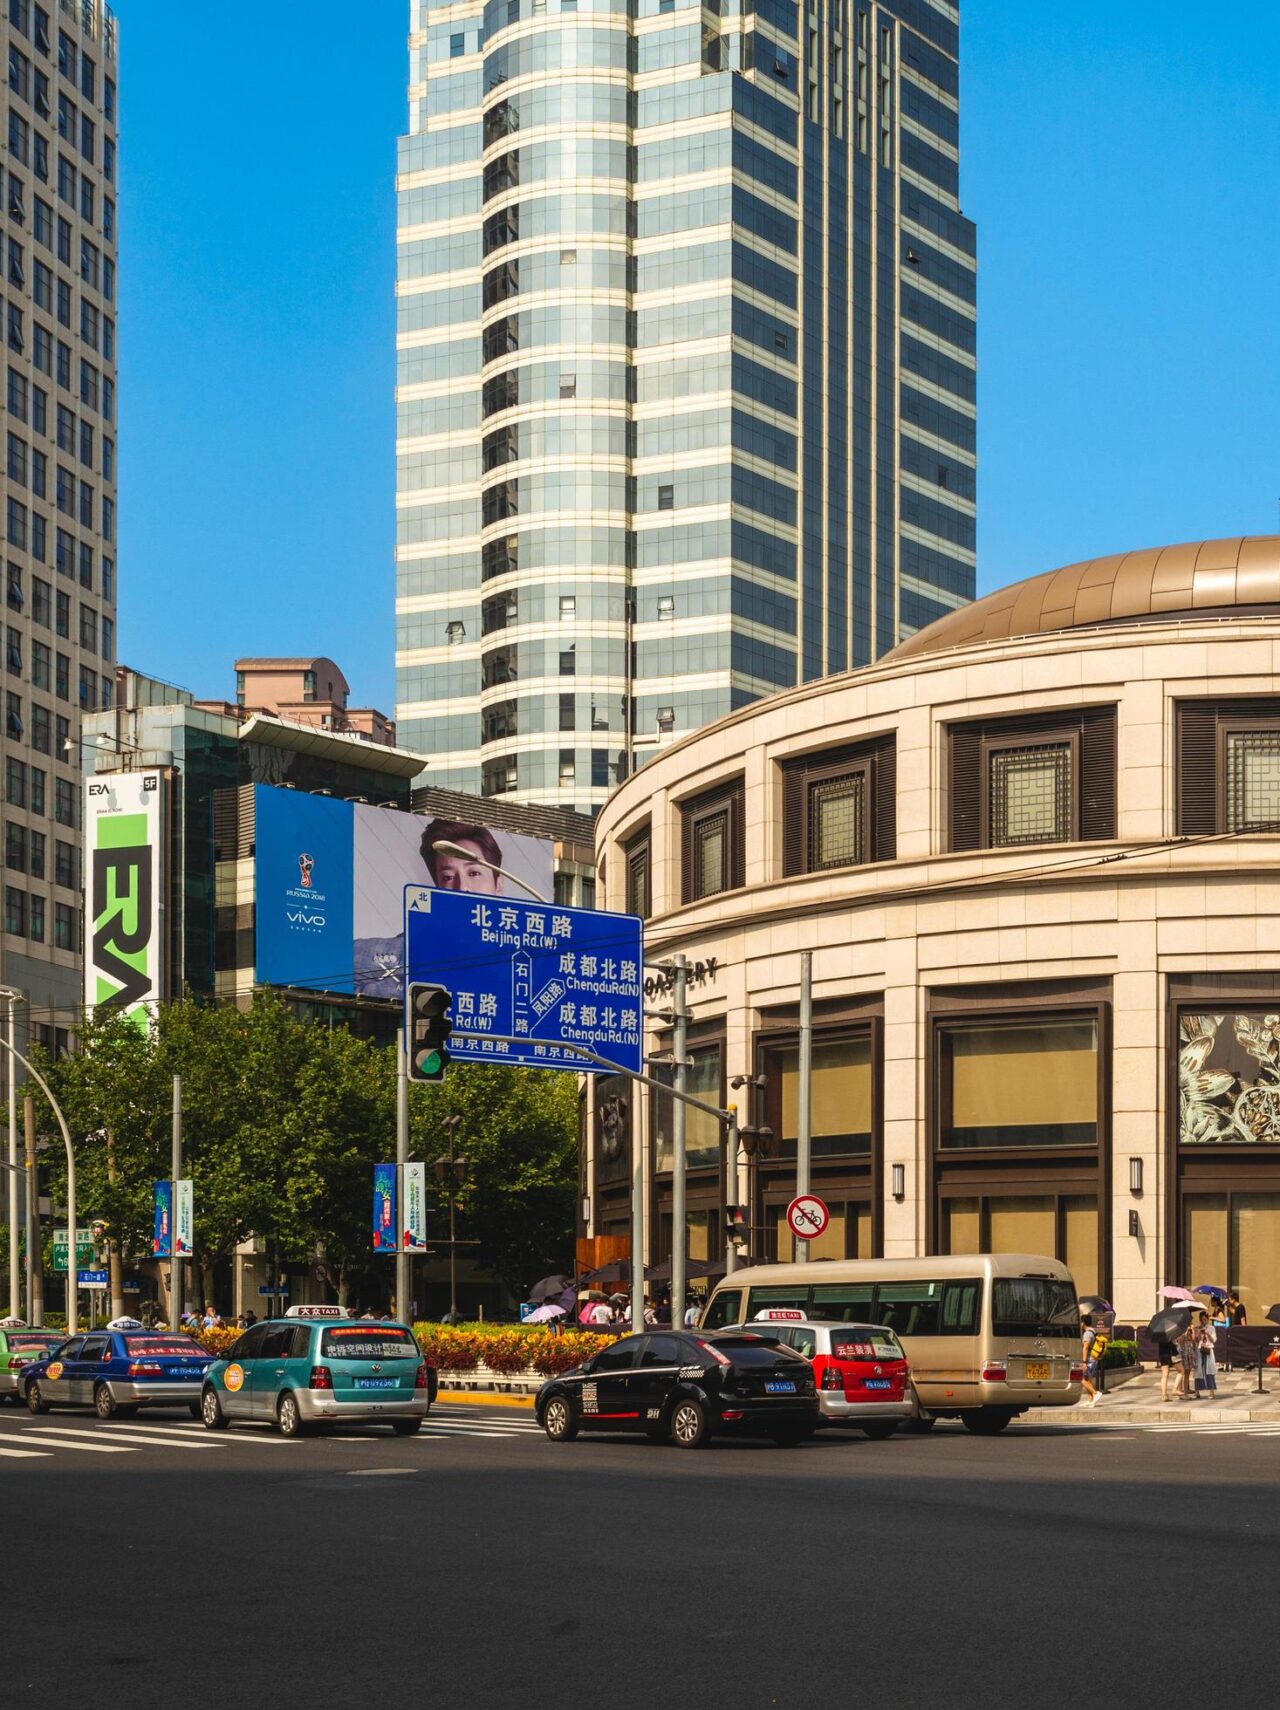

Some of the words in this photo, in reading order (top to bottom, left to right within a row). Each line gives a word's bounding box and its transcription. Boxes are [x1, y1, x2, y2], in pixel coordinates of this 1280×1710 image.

[89, 784, 110, 796] ERA
[144, 779, 157, 791] 5F
[286, 889, 310, 899] RUSSIA
[418, 892, 428, 902] 北
[471, 904, 573, 938] 北京西路
[481, 928, 521, 950] Beijing
[522, 933, 558, 950] Rd.(W)
[559, 952, 637, 983] 成都北路
[515, 963, 529, 1034] 石门二路
[531, 980, 563, 1017] 凤阳路
[559, 1001, 637, 1031] 成都北路
[300, 1308, 321, 1316] 大众
